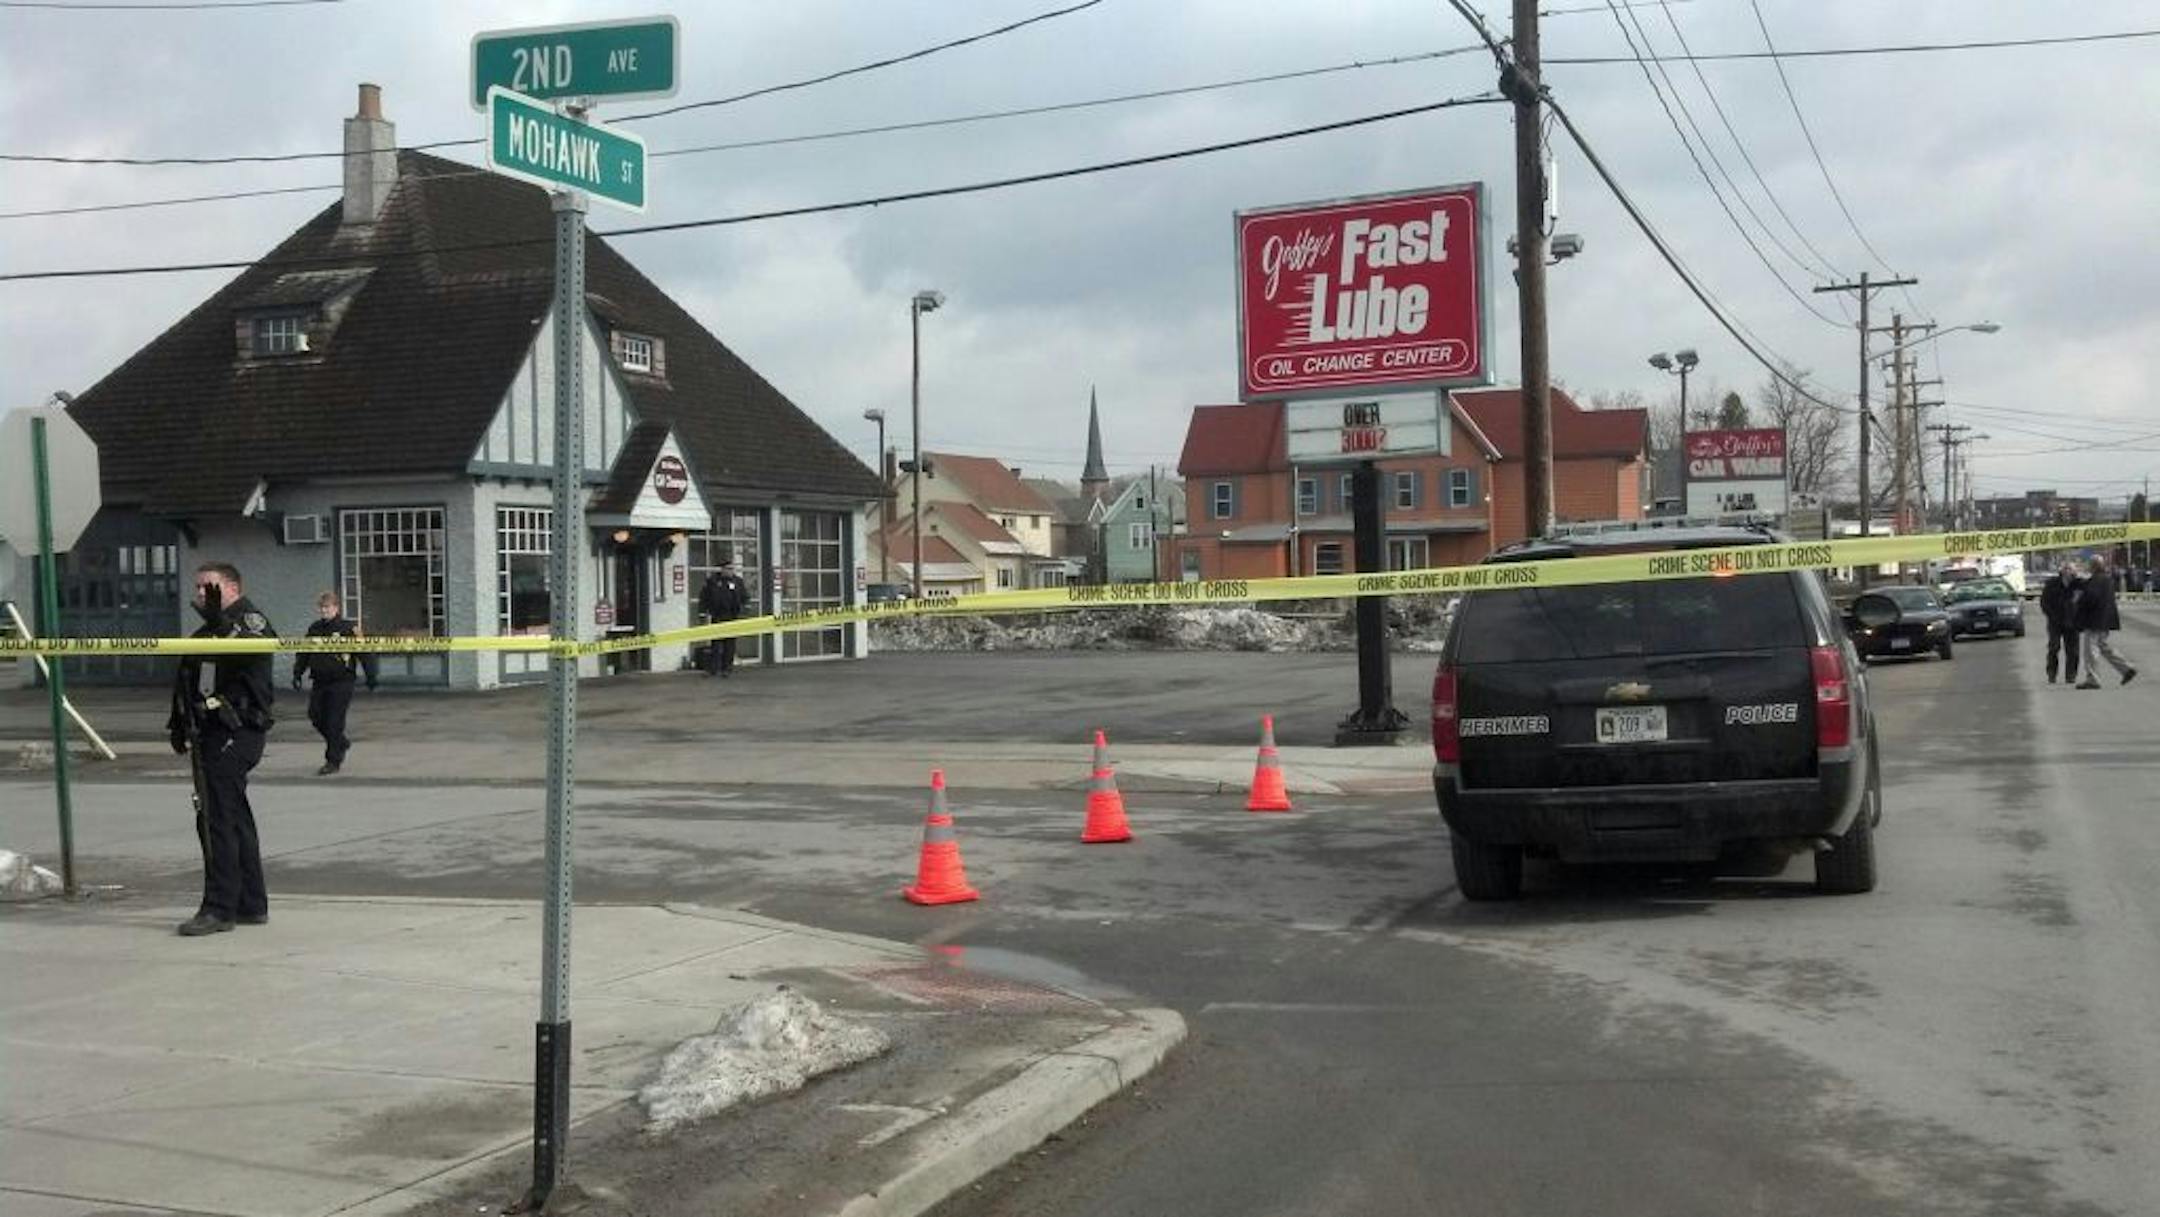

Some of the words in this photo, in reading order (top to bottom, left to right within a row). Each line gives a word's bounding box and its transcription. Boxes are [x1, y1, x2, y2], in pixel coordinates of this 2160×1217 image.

[512, 45, 572, 92] 2ND
[607, 49, 639, 72] AVE
[508, 112, 601, 184] MOHAWK
[621, 160, 635, 184] ST
[1340, 210, 1450, 285] Fast
[1309, 273, 1430, 343] Lube
[1269, 361, 1296, 377] OIL
[1303, 354, 1375, 374] CHANGE
[1382, 346, 1452, 367] CENTER
[1344, 402, 1380, 427] OVER
[1689, 458, 1727, 477] CAR
[1731, 456, 1783, 476] WASH
[1944, 536, 1983, 553] CRIME
[1987, 532, 2027, 549] SCENE
[2031, 530, 2048, 546] DO
[2051, 528, 2079, 544] NOT
[1649, 555, 1687, 575] CRIME
[1691, 552, 1732, 572] SCENE
[1735, 551, 1753, 569] DO
[1757, 548, 1783, 567] NOT
[1788, 545, 1832, 566] CROSS
[1068, 584, 1105, 601] CRIME
[1111, 582, 1150, 600] SCENE
[1153, 582, 1171, 599] DO
[1175, 581, 1200, 599] NOT
[1206, 581, 1248, 598] CROSS
[1357, 575, 1395, 591] CRIME
[1400, 573, 1440, 589] SCENE
[1442, 571, 1460, 586] DO
[1464, 569, 1488, 585] NOT
[1494, 567, 1538, 585] CROSS
[1459, 714, 1550, 736] HERKIMER
[1724, 703, 1799, 725] POLICE
